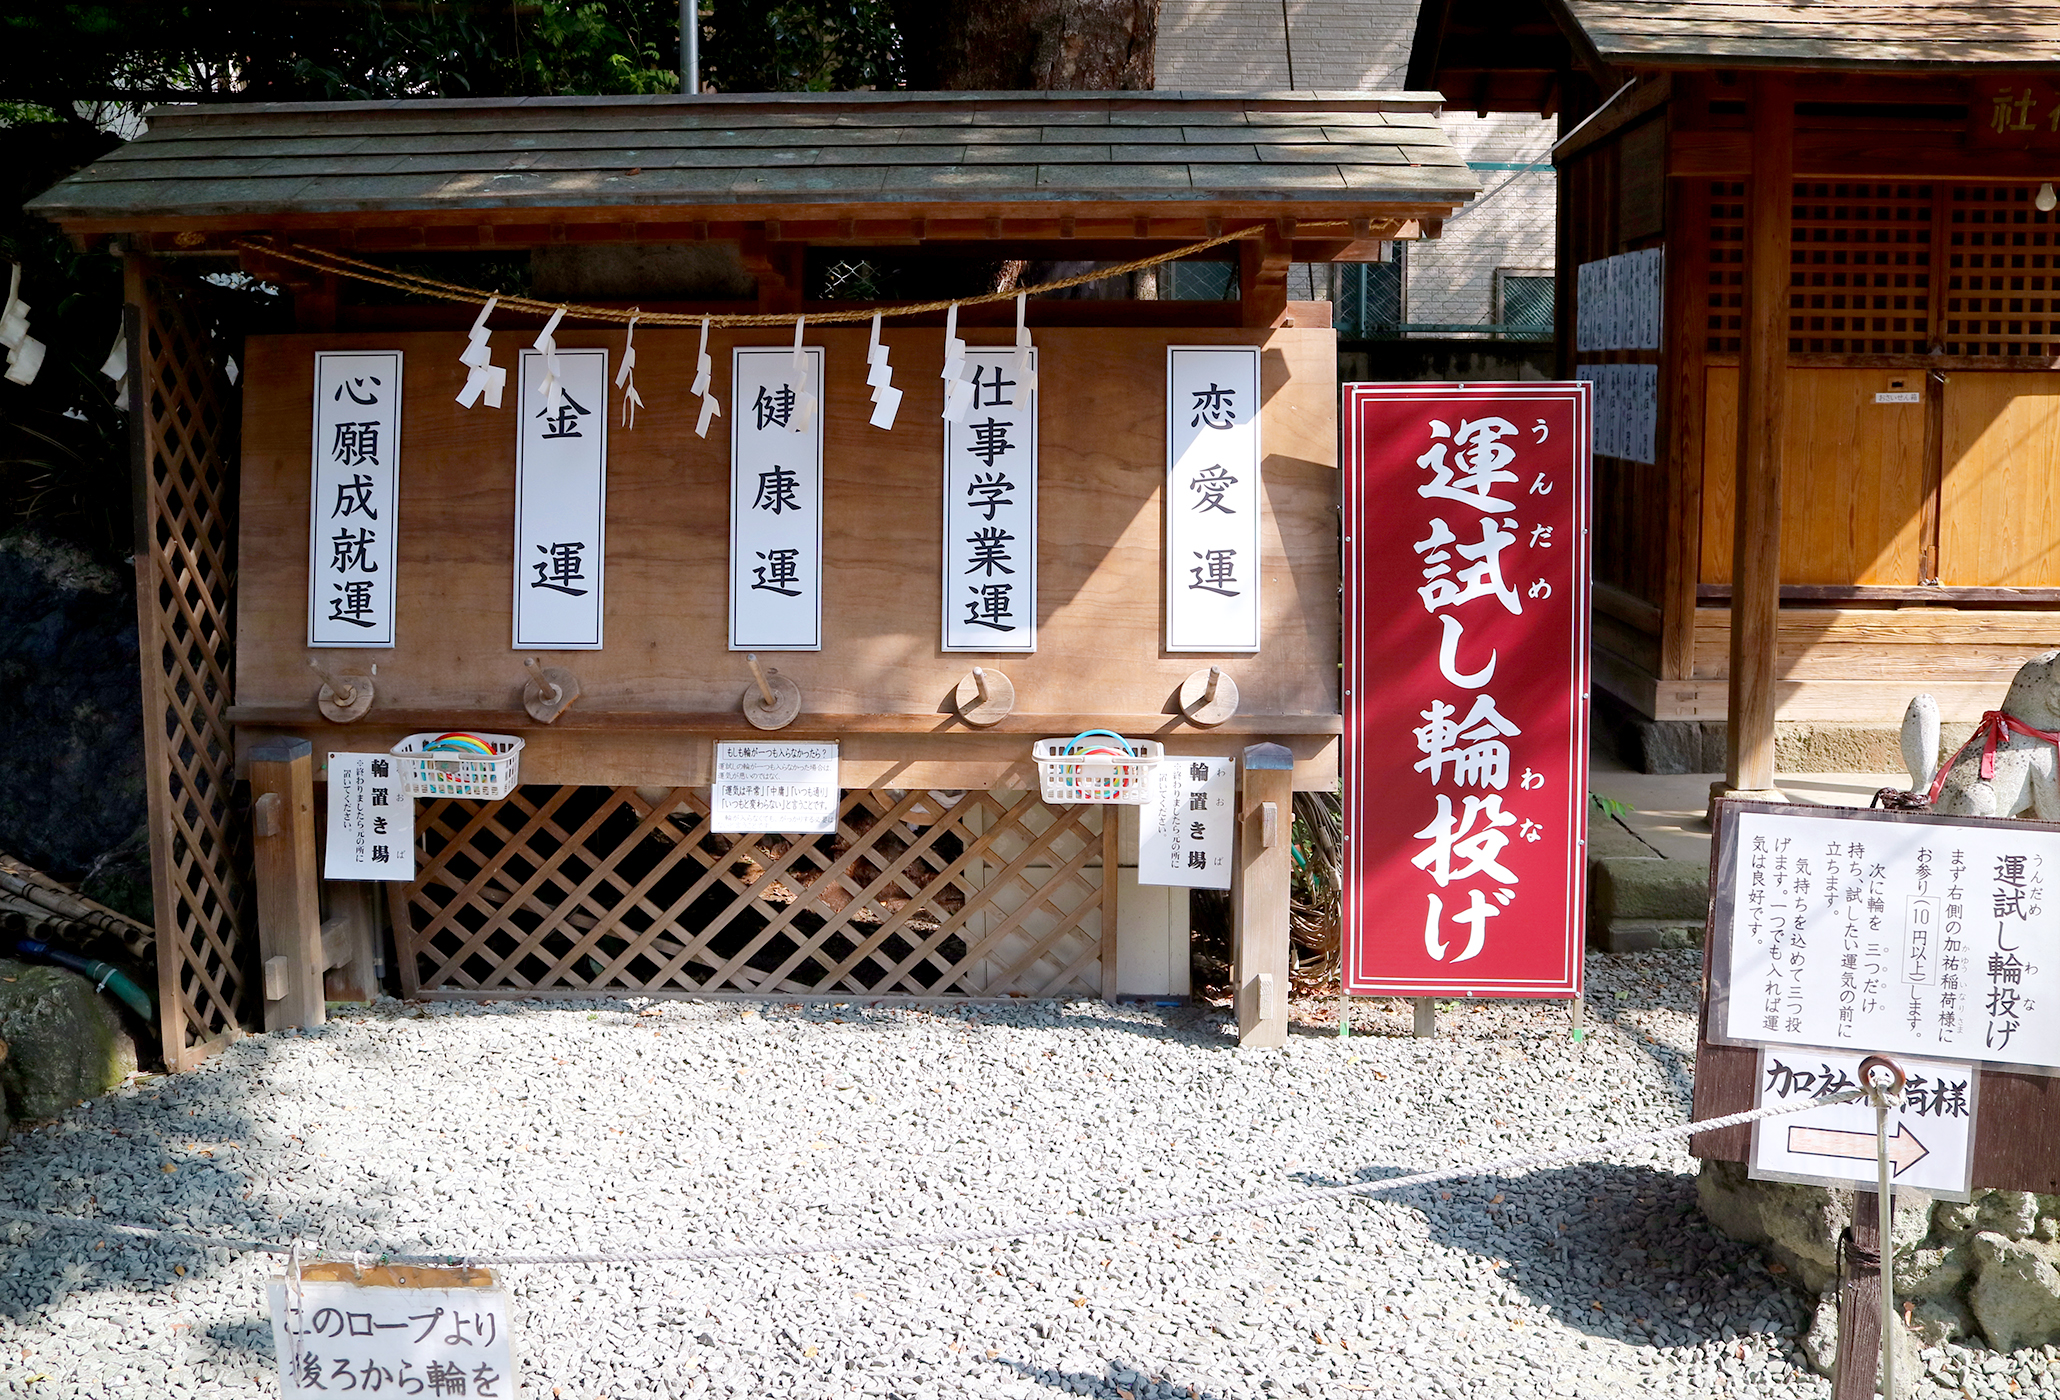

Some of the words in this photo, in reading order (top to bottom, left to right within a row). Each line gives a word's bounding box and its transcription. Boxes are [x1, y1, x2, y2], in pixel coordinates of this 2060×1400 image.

[1990, 86, 2060, 134] 社
[328, 374, 381, 628] 心願成就運
[530, 386, 592, 599] 金運
[751, 383, 803, 598] 健康運
[963, 364, 1017, 633] 仕事学業運
[1187, 382, 1242, 598] 恋愛運
[1527, 417, 1555, 602] うんだめ
[1411, 416, 1523, 965] 運試し輪投げ
[371, 758, 390, 864] 輪置き場
[1187, 762, 1209, 871] 輪置き場
[1519, 767, 1546, 843] わな
[1747, 835, 1768, 945] 気は良好です。
[1823, 841, 1843, 916] 立ちます。
[2028, 853, 2044, 917] うんだめ
[1762, 837, 1792, 1032] げます。一つでも入れば運
[1785, 857, 1812, 1034] 気持ちを込めて三つ投
[1838, 841, 1866, 1039] 持ち、試したい運気の前に
[1938, 849, 1966, 1044] まず右側の加祐稲荷様に
[1985, 854, 2028, 1051] 運試し輪投げ
[1765, 1058, 1970, 1118] 加祐荷様
[284, 1306, 497, 1348] このロープより
[289, 1350, 501, 1398] 後ろから輪を
